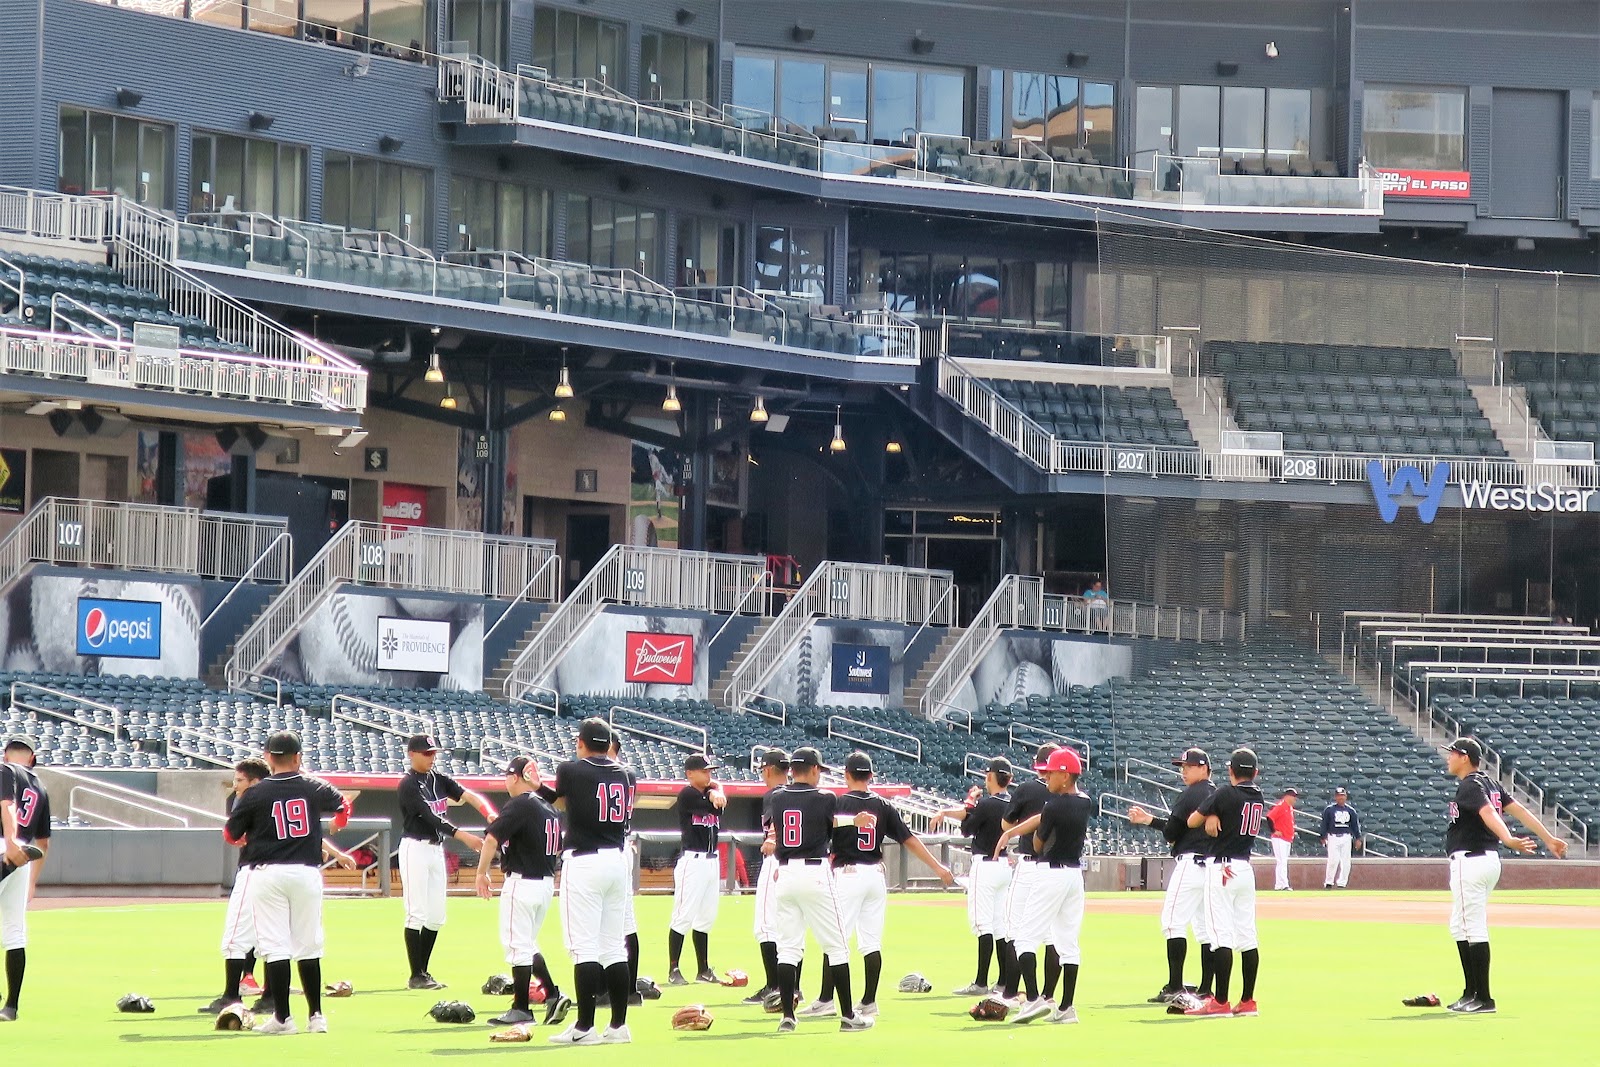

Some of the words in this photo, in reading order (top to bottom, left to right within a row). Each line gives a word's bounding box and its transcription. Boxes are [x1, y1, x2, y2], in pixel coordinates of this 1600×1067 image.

[1411, 180, 1428, 190] EL
[1431, 181, 1468, 191] PASO
[1118, 453, 1145, 470] 207
[1285, 459, 1317, 476] 208
[331, 489, 346, 501] HITS!
[1460, 479, 1594, 513] WestStar
[58, 522, 82, 546] 107
[362, 544, 382, 566] 108
[626, 571, 644, 591] 109
[831, 581, 848, 600] 110
[1046, 608, 1060, 625] 111
[108, 616, 152, 645] pepsi
[402, 641, 445, 654] PROVIDENCE
[635, 647, 682, 665] Budweiser
[596, 783, 625, 822] 13
[271, 799, 310, 840] 19
[782, 809, 803, 847] 8
[1239, 801, 1263, 837] 10
[545, 818, 560, 856] 11
